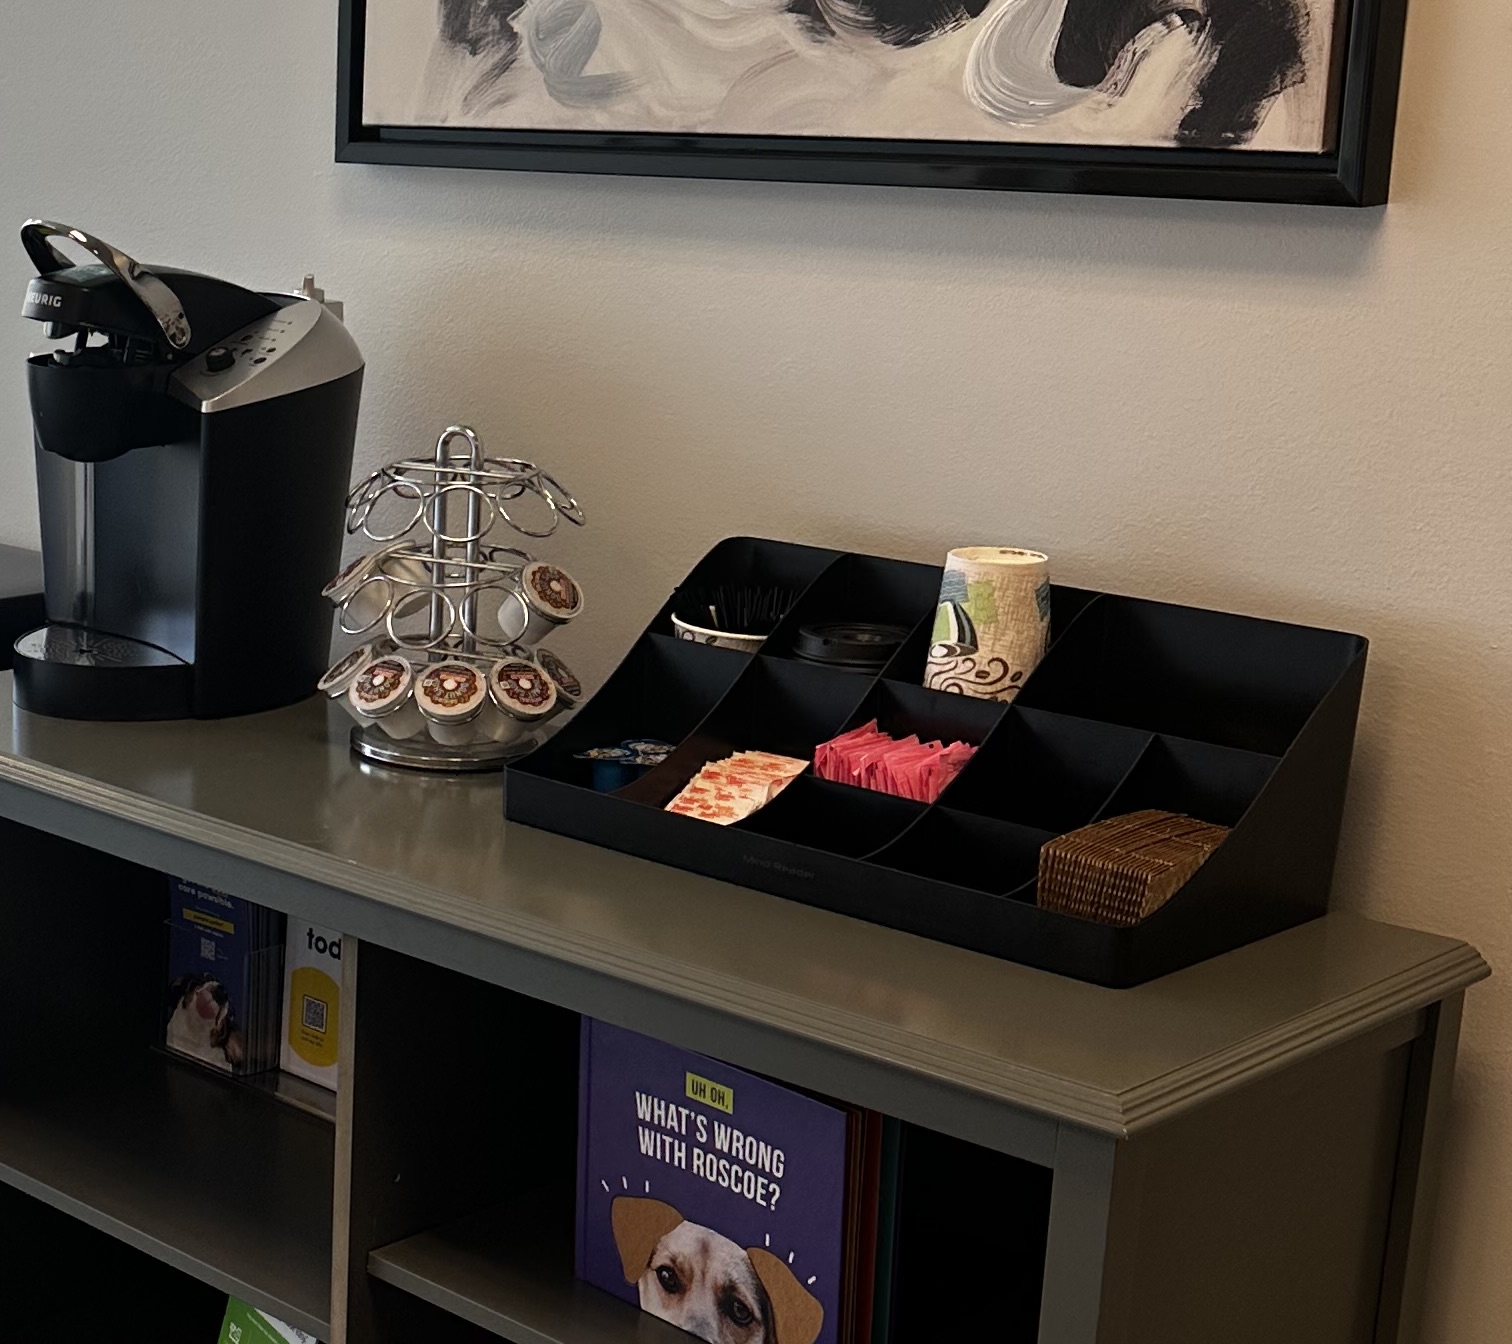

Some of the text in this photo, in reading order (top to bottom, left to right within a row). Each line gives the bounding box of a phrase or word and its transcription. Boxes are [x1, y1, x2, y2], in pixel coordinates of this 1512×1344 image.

[27, 291, 63, 308] EURIG
[691, 1078, 729, 1110] UH OH.
[635, 1090, 785, 1179] WHAT'S WRONG
[638, 1125, 781, 1212] WITH ROSCOE?
